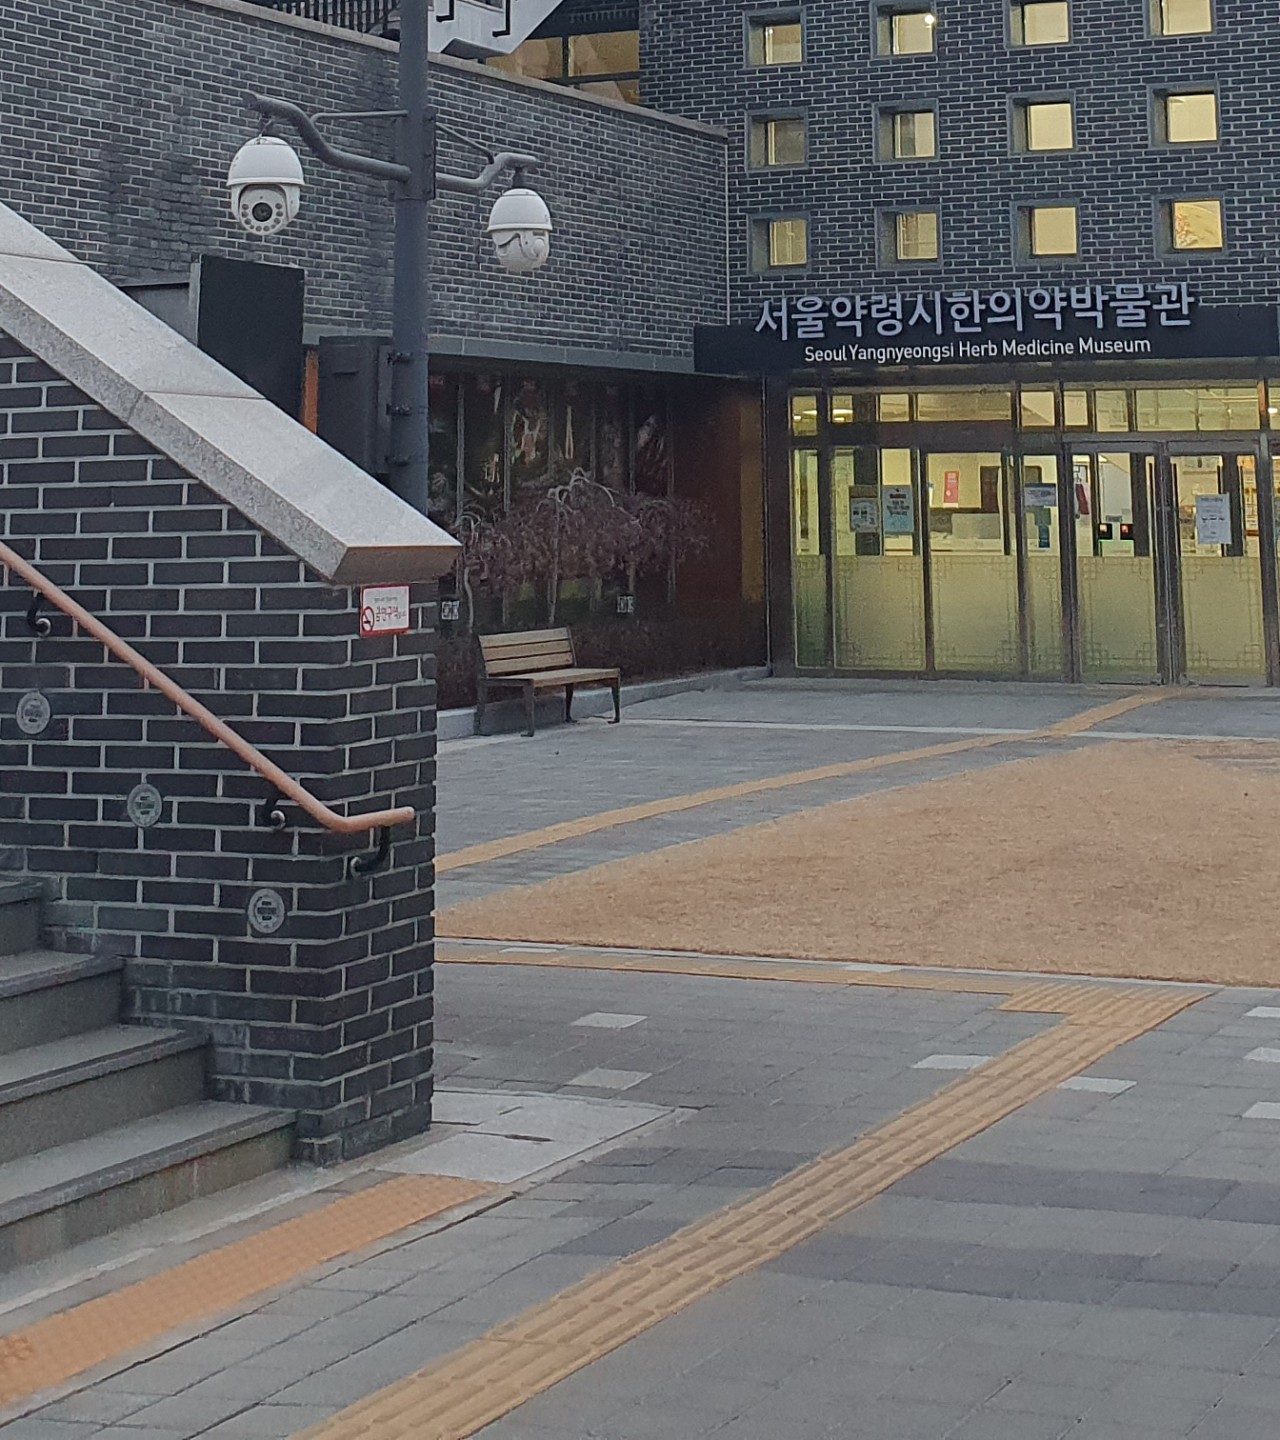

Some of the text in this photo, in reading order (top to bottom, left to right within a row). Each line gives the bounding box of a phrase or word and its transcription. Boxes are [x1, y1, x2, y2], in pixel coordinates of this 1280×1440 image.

[754, 283, 1195, 342] 서울약령시한의약박물관
[804, 336, 1151, 364] Seoul Yangnyeongsi Herb Medicine Museum
